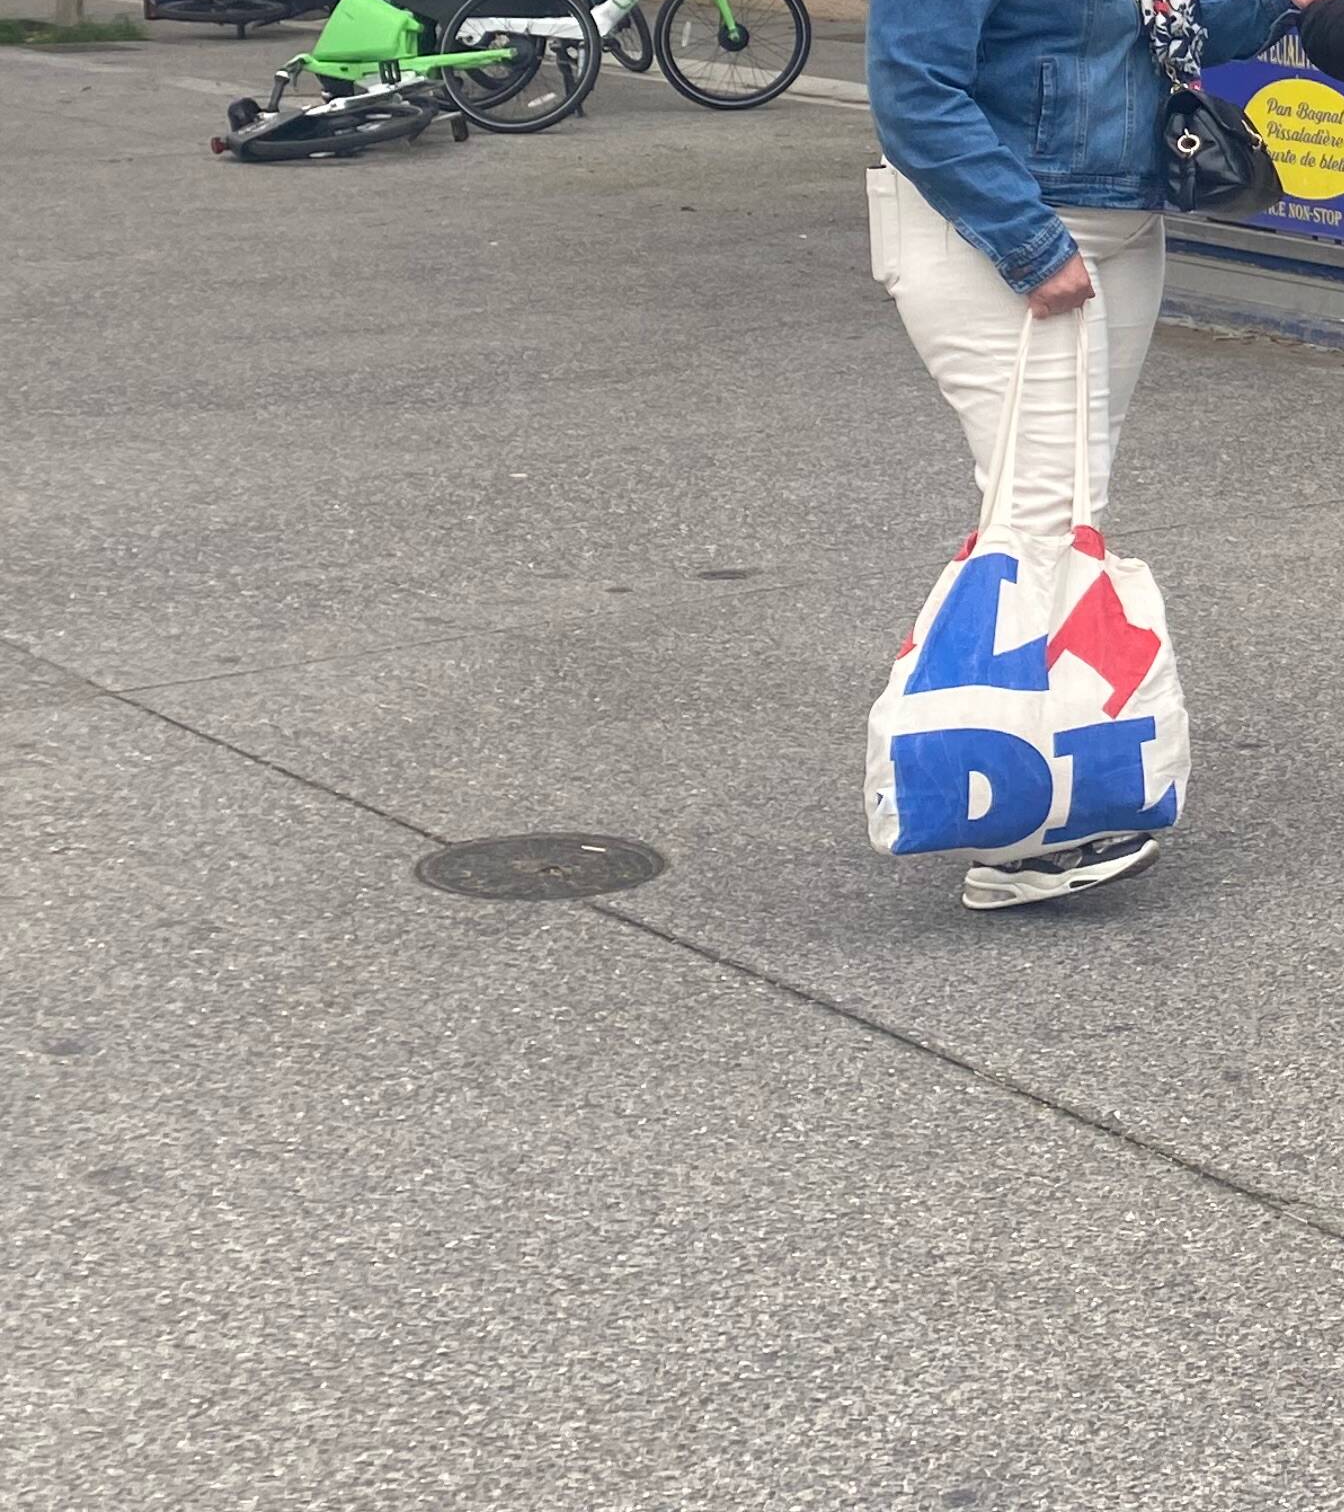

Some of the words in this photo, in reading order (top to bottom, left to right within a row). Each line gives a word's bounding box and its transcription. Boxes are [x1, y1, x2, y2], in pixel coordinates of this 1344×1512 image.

[1267, 97, 1292, 117] Pan
[1267, 121, 1344, 148] Pissaladière
[1269, 149, 1297, 165] urte
[1299, 151, 1316, 168] de
[1288, 202, 1342, 226] NON-STOP
